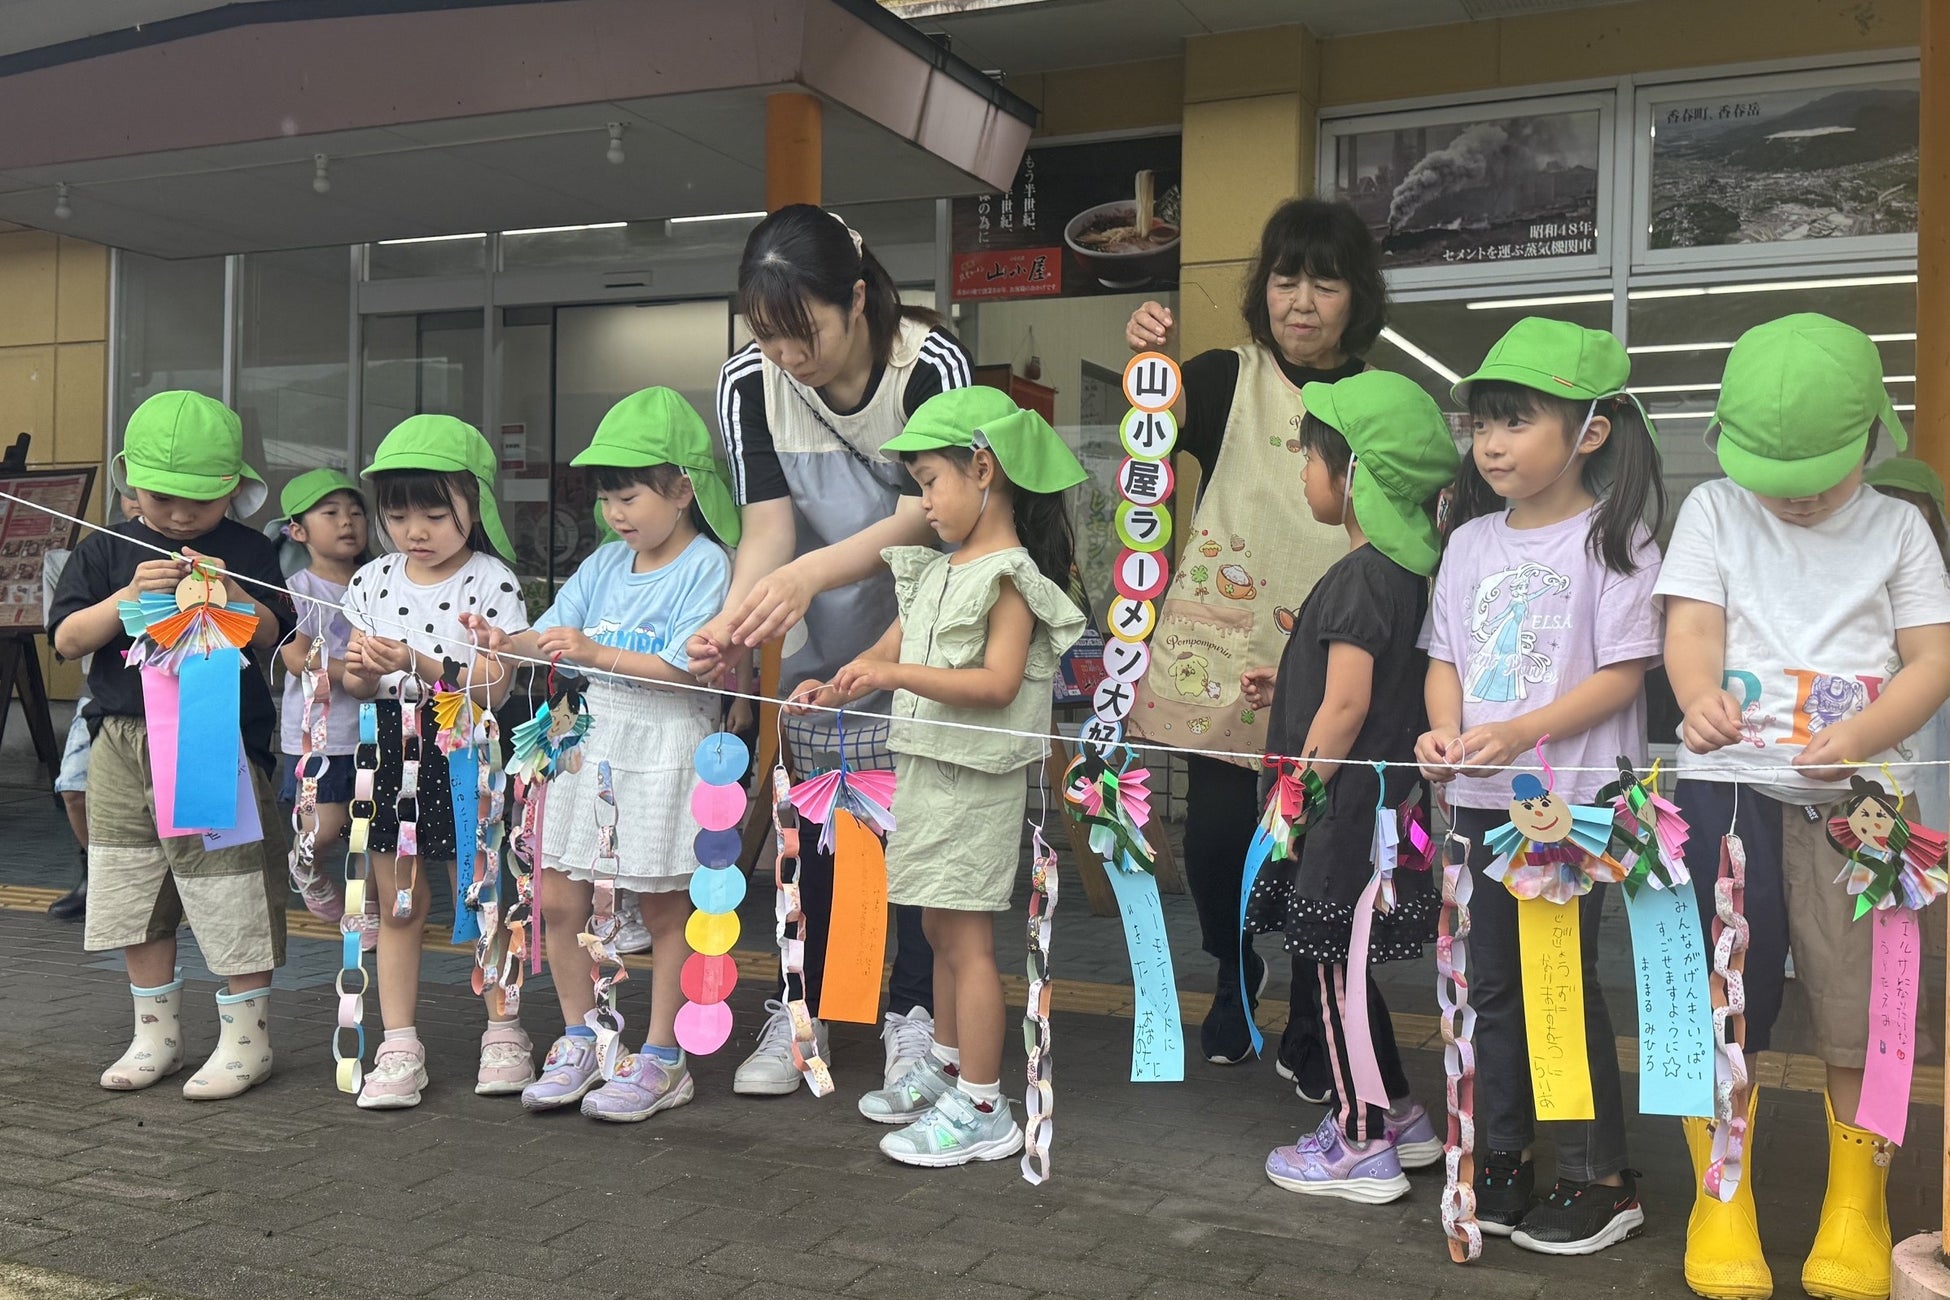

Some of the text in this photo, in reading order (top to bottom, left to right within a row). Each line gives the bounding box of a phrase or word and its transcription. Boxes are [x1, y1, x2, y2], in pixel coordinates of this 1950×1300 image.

[1530, 221, 1592, 239] 昭和48年
[1442, 238, 1592, 262] セメントを運ぶ蒸気機関車
[1531, 614, 1573, 630] ELSA
[1166, 634, 1233, 659] Pompompurin
